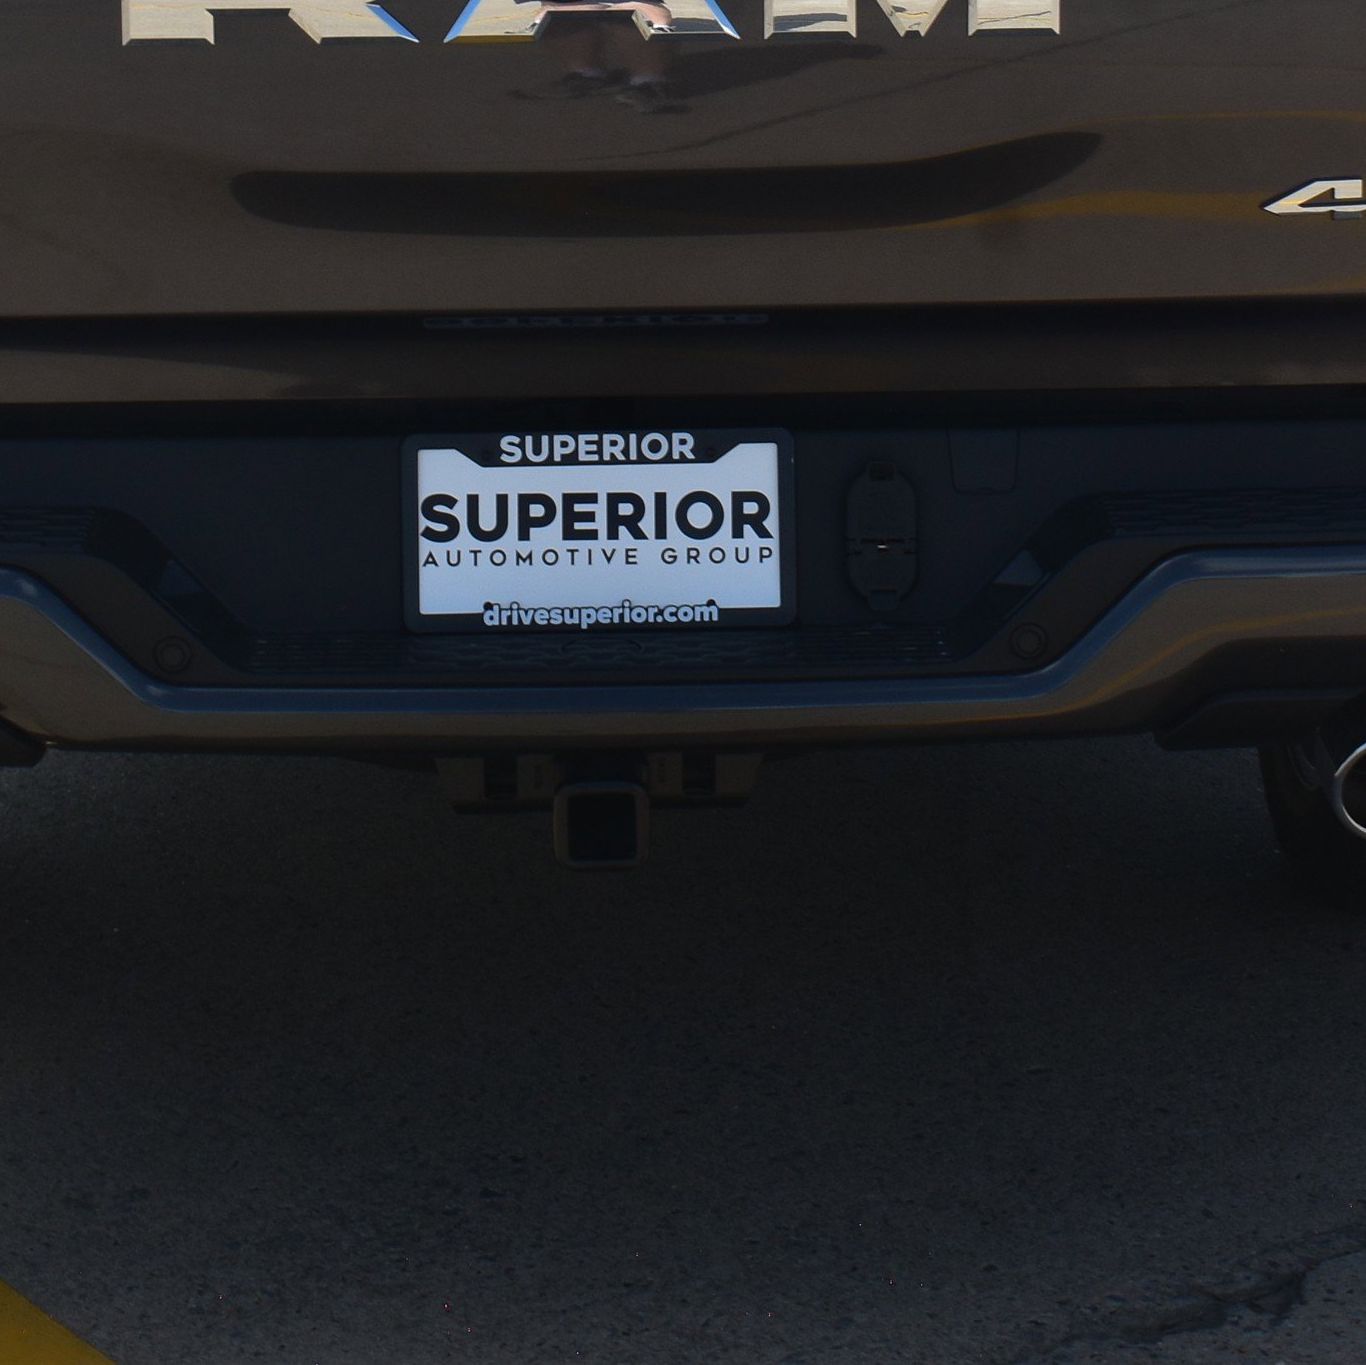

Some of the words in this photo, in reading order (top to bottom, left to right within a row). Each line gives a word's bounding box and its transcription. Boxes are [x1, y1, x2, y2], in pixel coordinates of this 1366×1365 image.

[499, 432, 695, 463] SUPERIOR
[420, 491, 774, 543] SUPERIOR
[422, 548, 638, 568] AUTOMOTIVE
[660, 546, 773, 565] GROUP
[483, 599, 719, 629] drivesuperior.com
